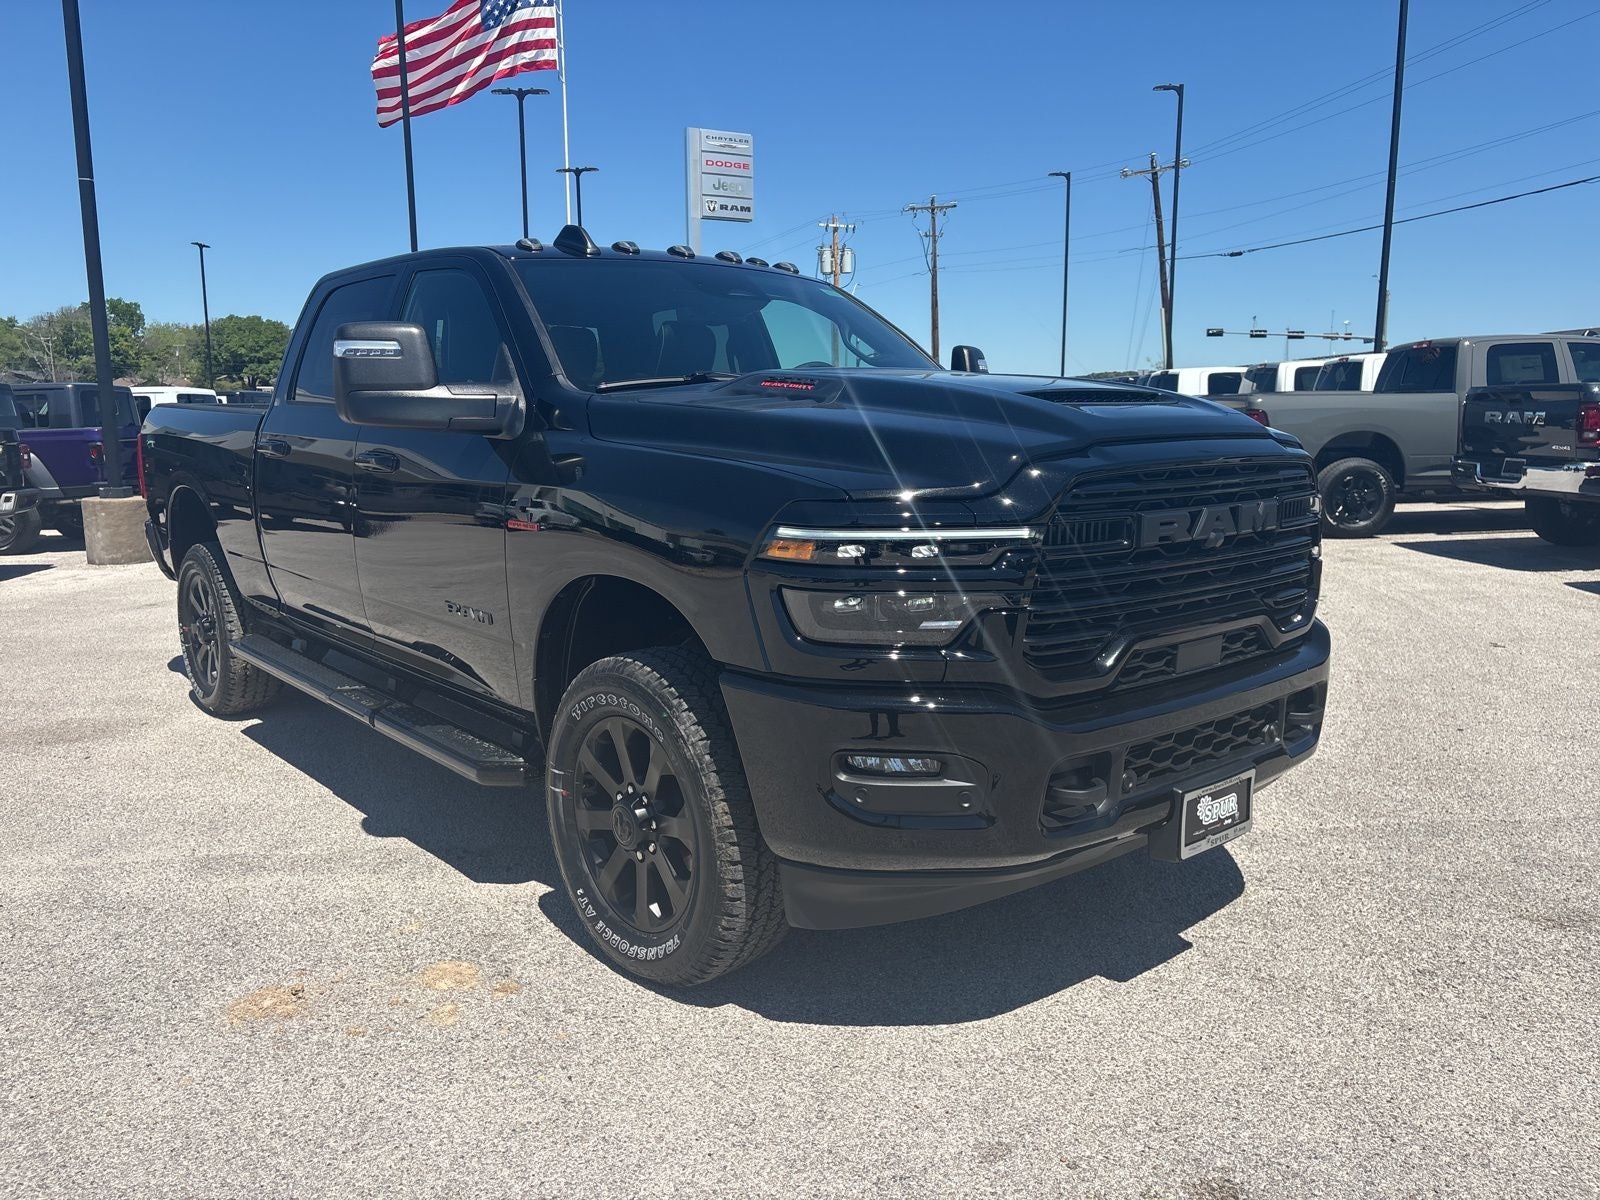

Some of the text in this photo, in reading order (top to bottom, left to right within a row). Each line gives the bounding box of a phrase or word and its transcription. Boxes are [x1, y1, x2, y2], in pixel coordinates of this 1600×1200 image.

[705, 134, 749, 144] CHRYSLER
[705, 159, 750, 170] DODGE
[712, 178, 744, 195] Jeep
[719, 203, 752, 213] RAM
[1484, 411, 1546, 425] RAM
[1139, 501, 1278, 548] RAM
[1204, 796, 1238, 822] SPUR
[595, 920, 681, 961] TRANSFORCE
